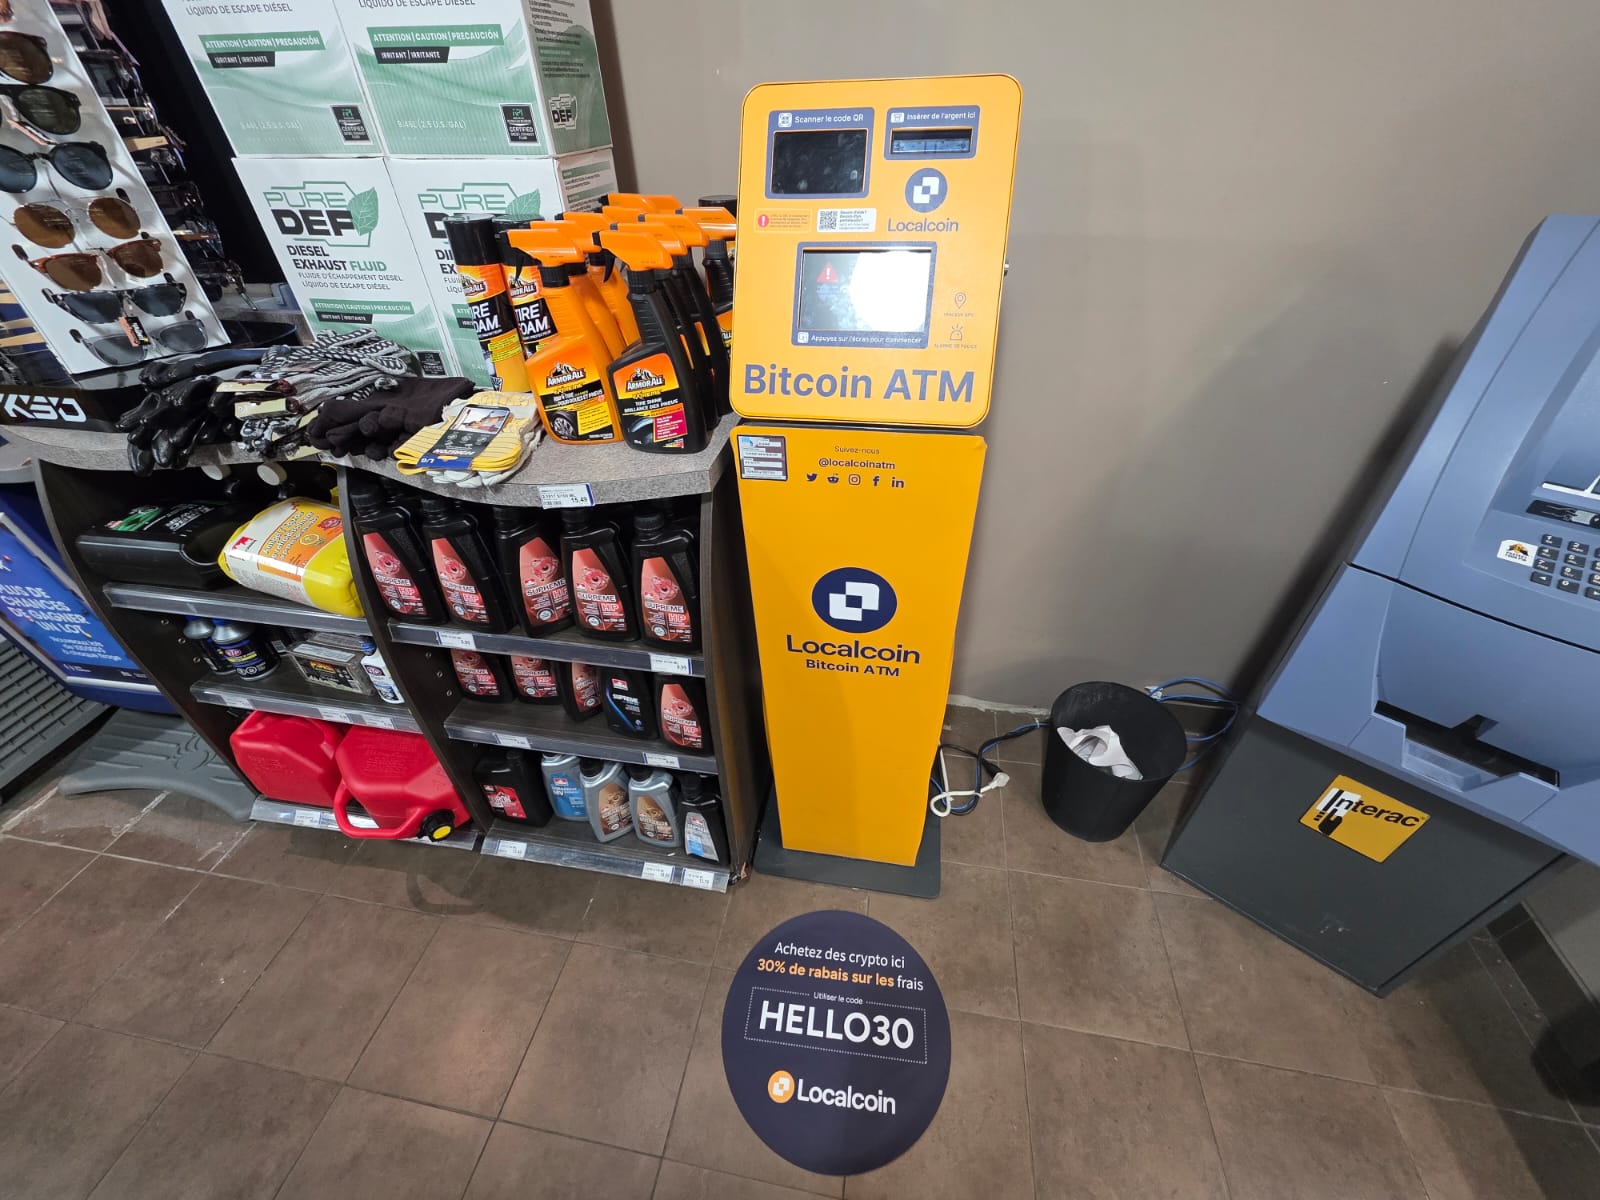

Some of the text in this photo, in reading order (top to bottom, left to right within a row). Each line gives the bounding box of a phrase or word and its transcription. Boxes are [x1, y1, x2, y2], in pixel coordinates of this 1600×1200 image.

[186, 2, 292, 16] LÍQUIDO DE ESCAPE DIÉSEL
[205, 35, 320, 49] ATTENTION CAUTION PRECAUCIÓN
[373, 29, 499, 42] ATTENTION CAUTION PRECAUCIÓN
[552, 109, 573, 122] DEF
[794, 114, 864, 124] Scanner le code QR
[941, 112, 966, 121] l'argent
[263, 192, 348, 208] PURE
[418, 194, 508, 210] PURE
[271, 209, 356, 236] DEF
[887, 218, 959, 232] Localcoin
[286, 245, 330, 257] DIESEL
[293, 259, 387, 272] EXHAUST FLUID
[323, 271, 377, 281] D'ÉCHAPPEMENT
[302, 280, 328, 289] LÍQUIDO
[472, 302, 490, 319] RE
[474, 315, 499, 332] OAM
[518, 316, 548, 335] OAM
[811, 335, 838, 343] Appuyez
[744, 364, 975, 403] Bitcoin ATM
[834, 446, 880, 455] Suivez-nous
[818, 458, 896, 469] @localcoinatm
[526, 578, 566, 596] SUPREME
[2, 596, 72, 612] CHANCES
[577, 592, 616, 602] SUPREME
[645, 601, 684, 613] SUPREME
[786, 634, 921, 664] Localcoin
[806, 659, 899, 676] Bitcoin ATM
[1322, 790, 1420, 827] Interac
[775, 942, 905, 969] Achetez des crypto ici
[757, 958, 924, 990] 30% de rabais sur les frais
[814, 992, 863, 1004] Utiliser le code
[759, 1000, 914, 1049] HELLO30
[797, 1079, 896, 1115] Localcoin
